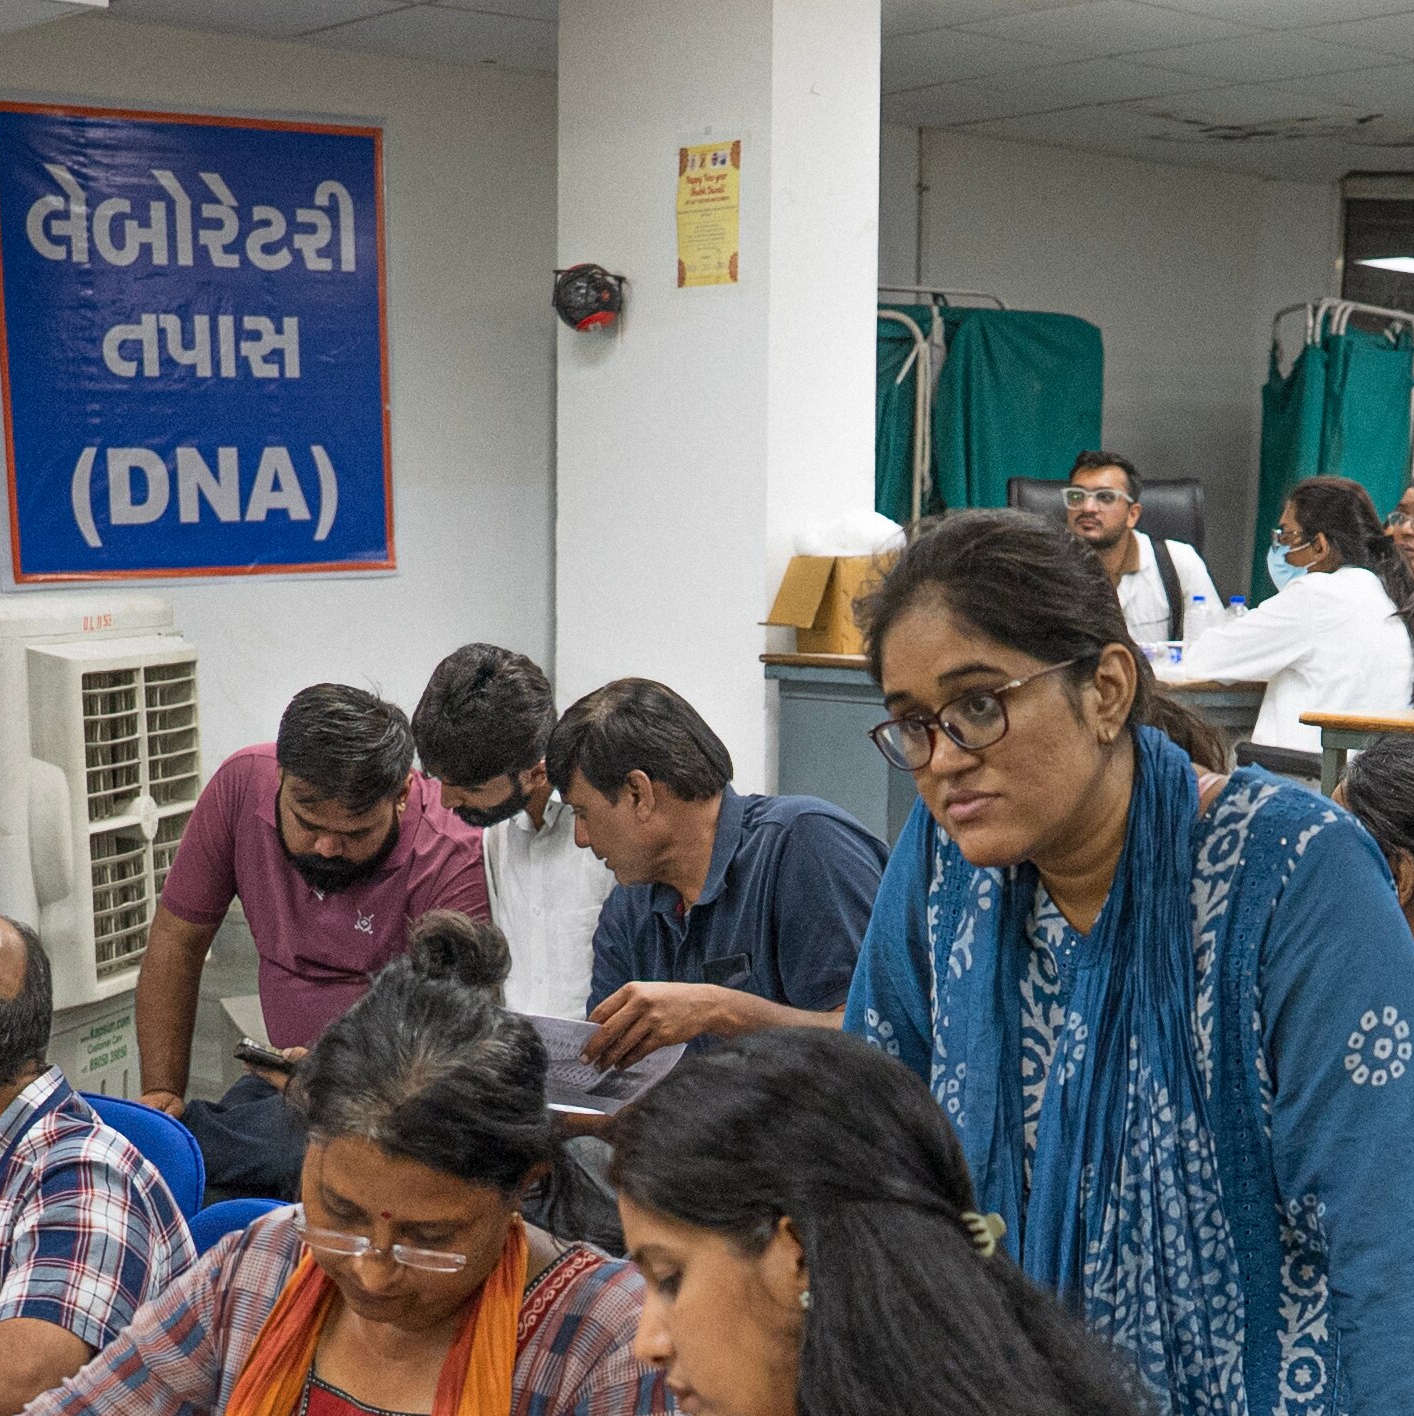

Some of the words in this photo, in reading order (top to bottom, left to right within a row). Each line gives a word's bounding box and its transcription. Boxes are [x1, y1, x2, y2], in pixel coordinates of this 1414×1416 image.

[25, 163, 357, 273] લેબોરેટરી
[102, 312, 302, 379] તપાસ
[71, 445, 339, 548] (DNA)
